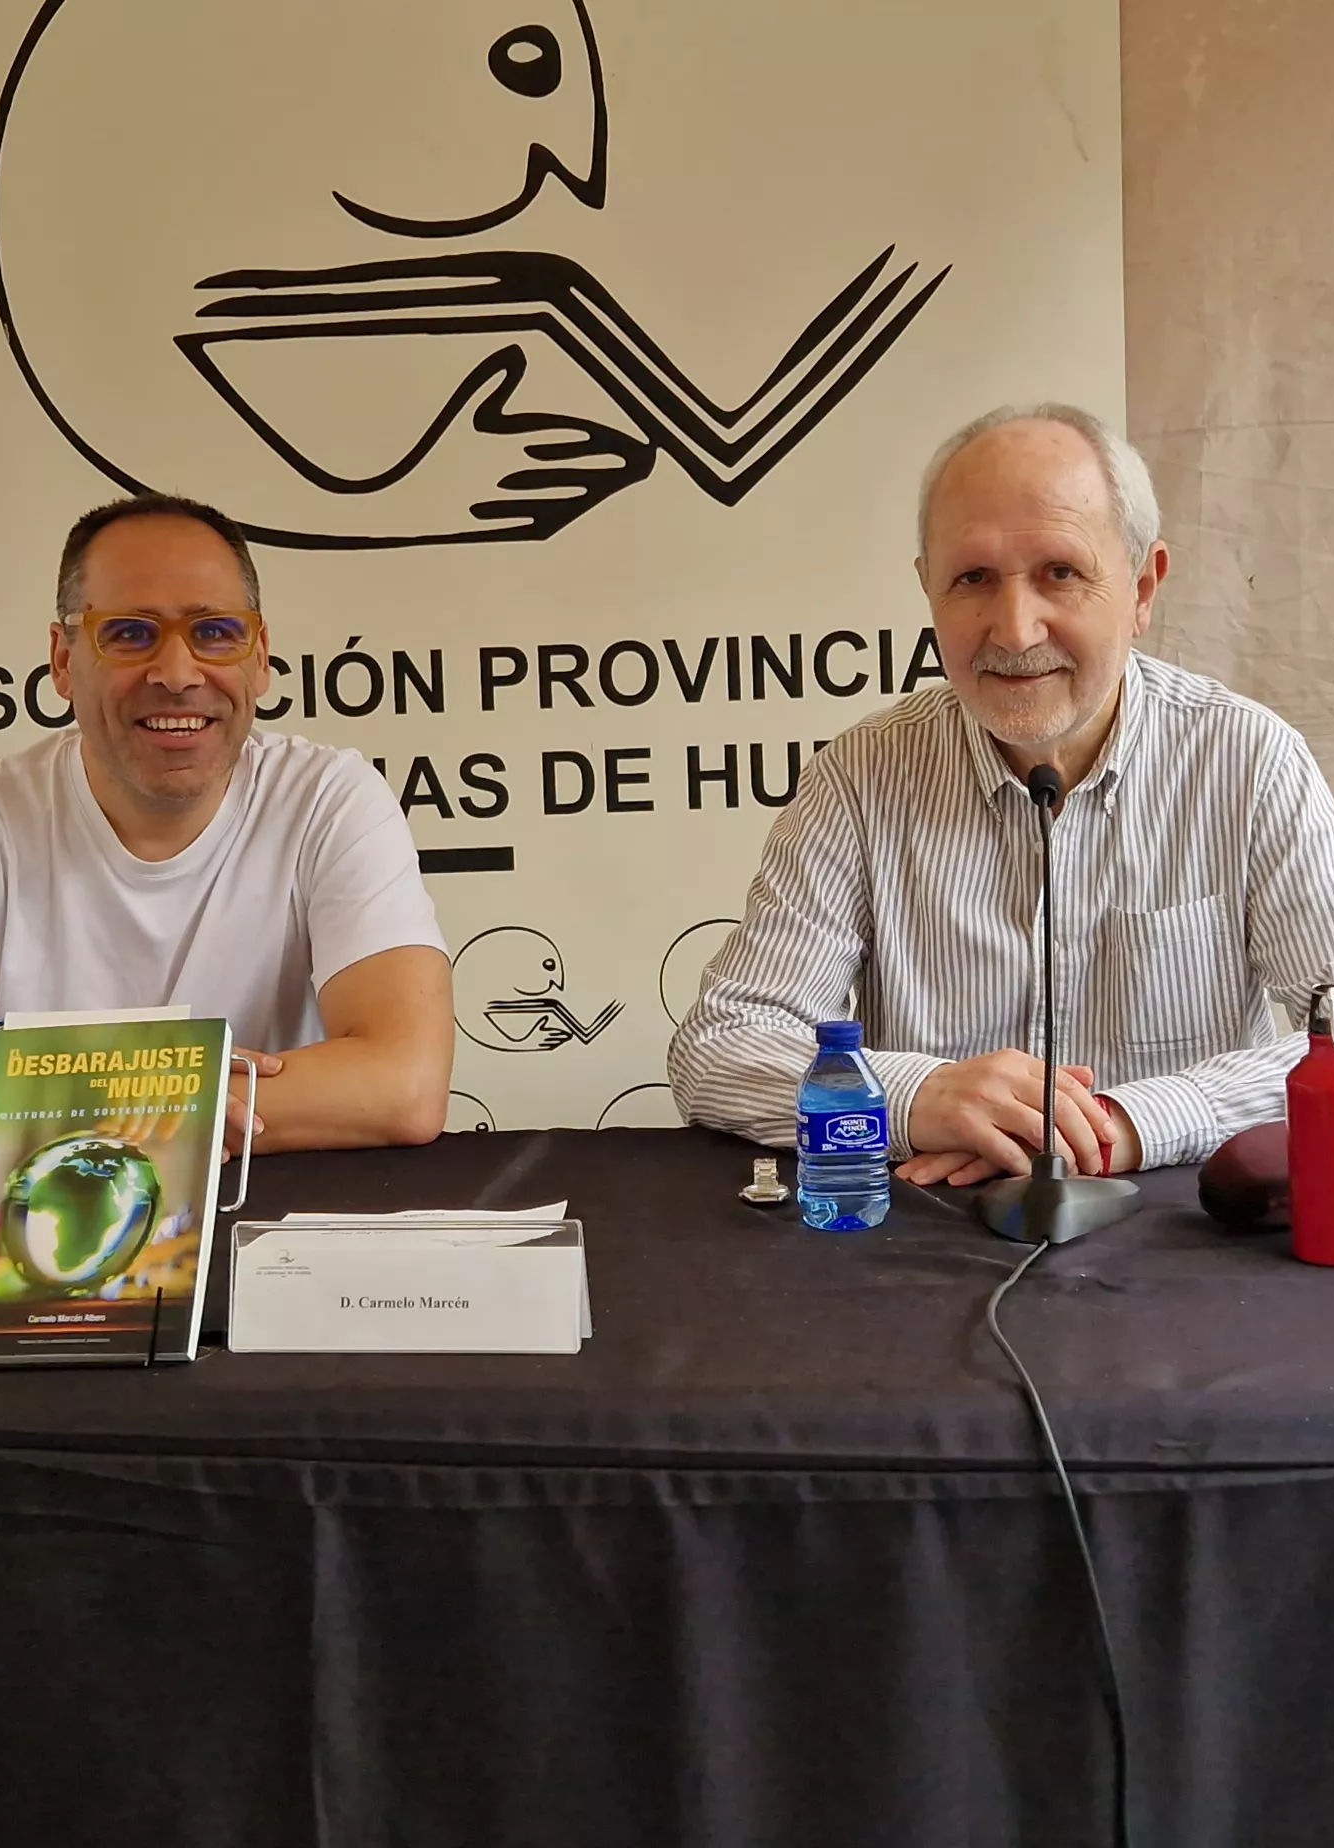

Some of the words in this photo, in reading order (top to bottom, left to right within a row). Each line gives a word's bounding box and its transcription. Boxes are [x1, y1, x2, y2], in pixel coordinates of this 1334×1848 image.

[479, 627, 950, 712] PROVINCIA
[542, 747, 655, 816] DE
[7, 1046, 205, 1077] DESBARAJUSTE
[89, 1078, 108, 1088] DEL
[107, 1073, 201, 1099] MUNDO
[70, 1108, 86, 1118] DE
[340, 1297, 355, 1309] D.
[359, 1297, 415, 1309] Carmelo
[419, 1297, 470, 1309] Marcén
